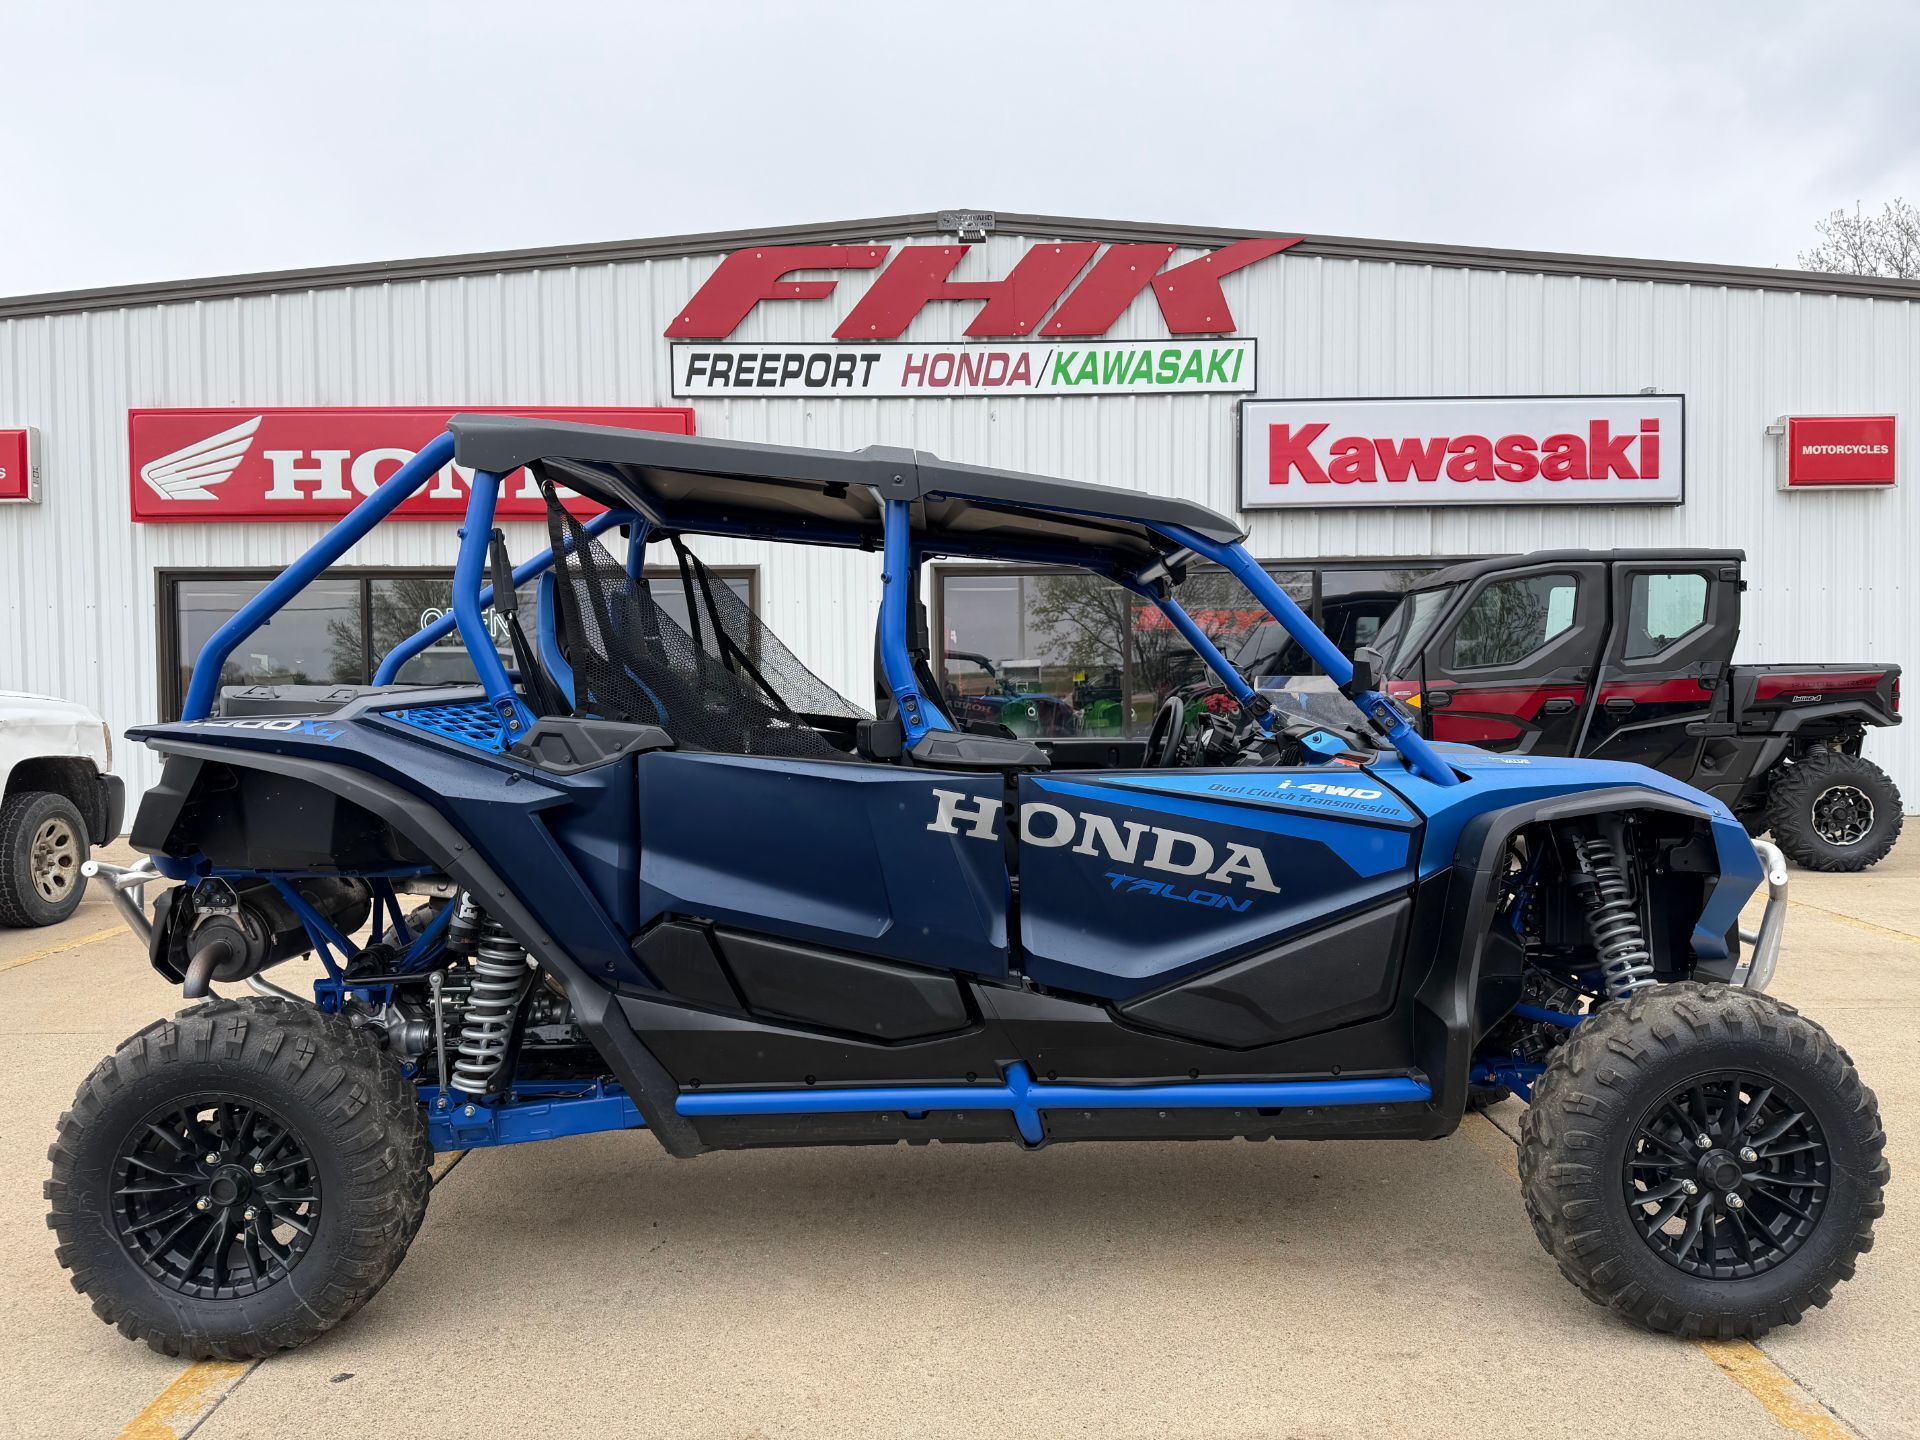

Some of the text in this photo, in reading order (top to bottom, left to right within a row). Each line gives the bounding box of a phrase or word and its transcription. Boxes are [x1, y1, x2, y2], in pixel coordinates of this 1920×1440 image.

[663, 237, 1307, 338] FHK
[684, 353, 882, 389] FREEPORT
[1268, 417, 1660, 485] Kawasaki
[1802, 444, 1889, 455] MOTORCYCLES
[1207, 783, 1401, 816] Dual Clutch Transmission
[1277, 780, 1383, 800] i-4WD
[926, 788, 1282, 894] HONDA
[1104, 872, 1254, 912] TALON
